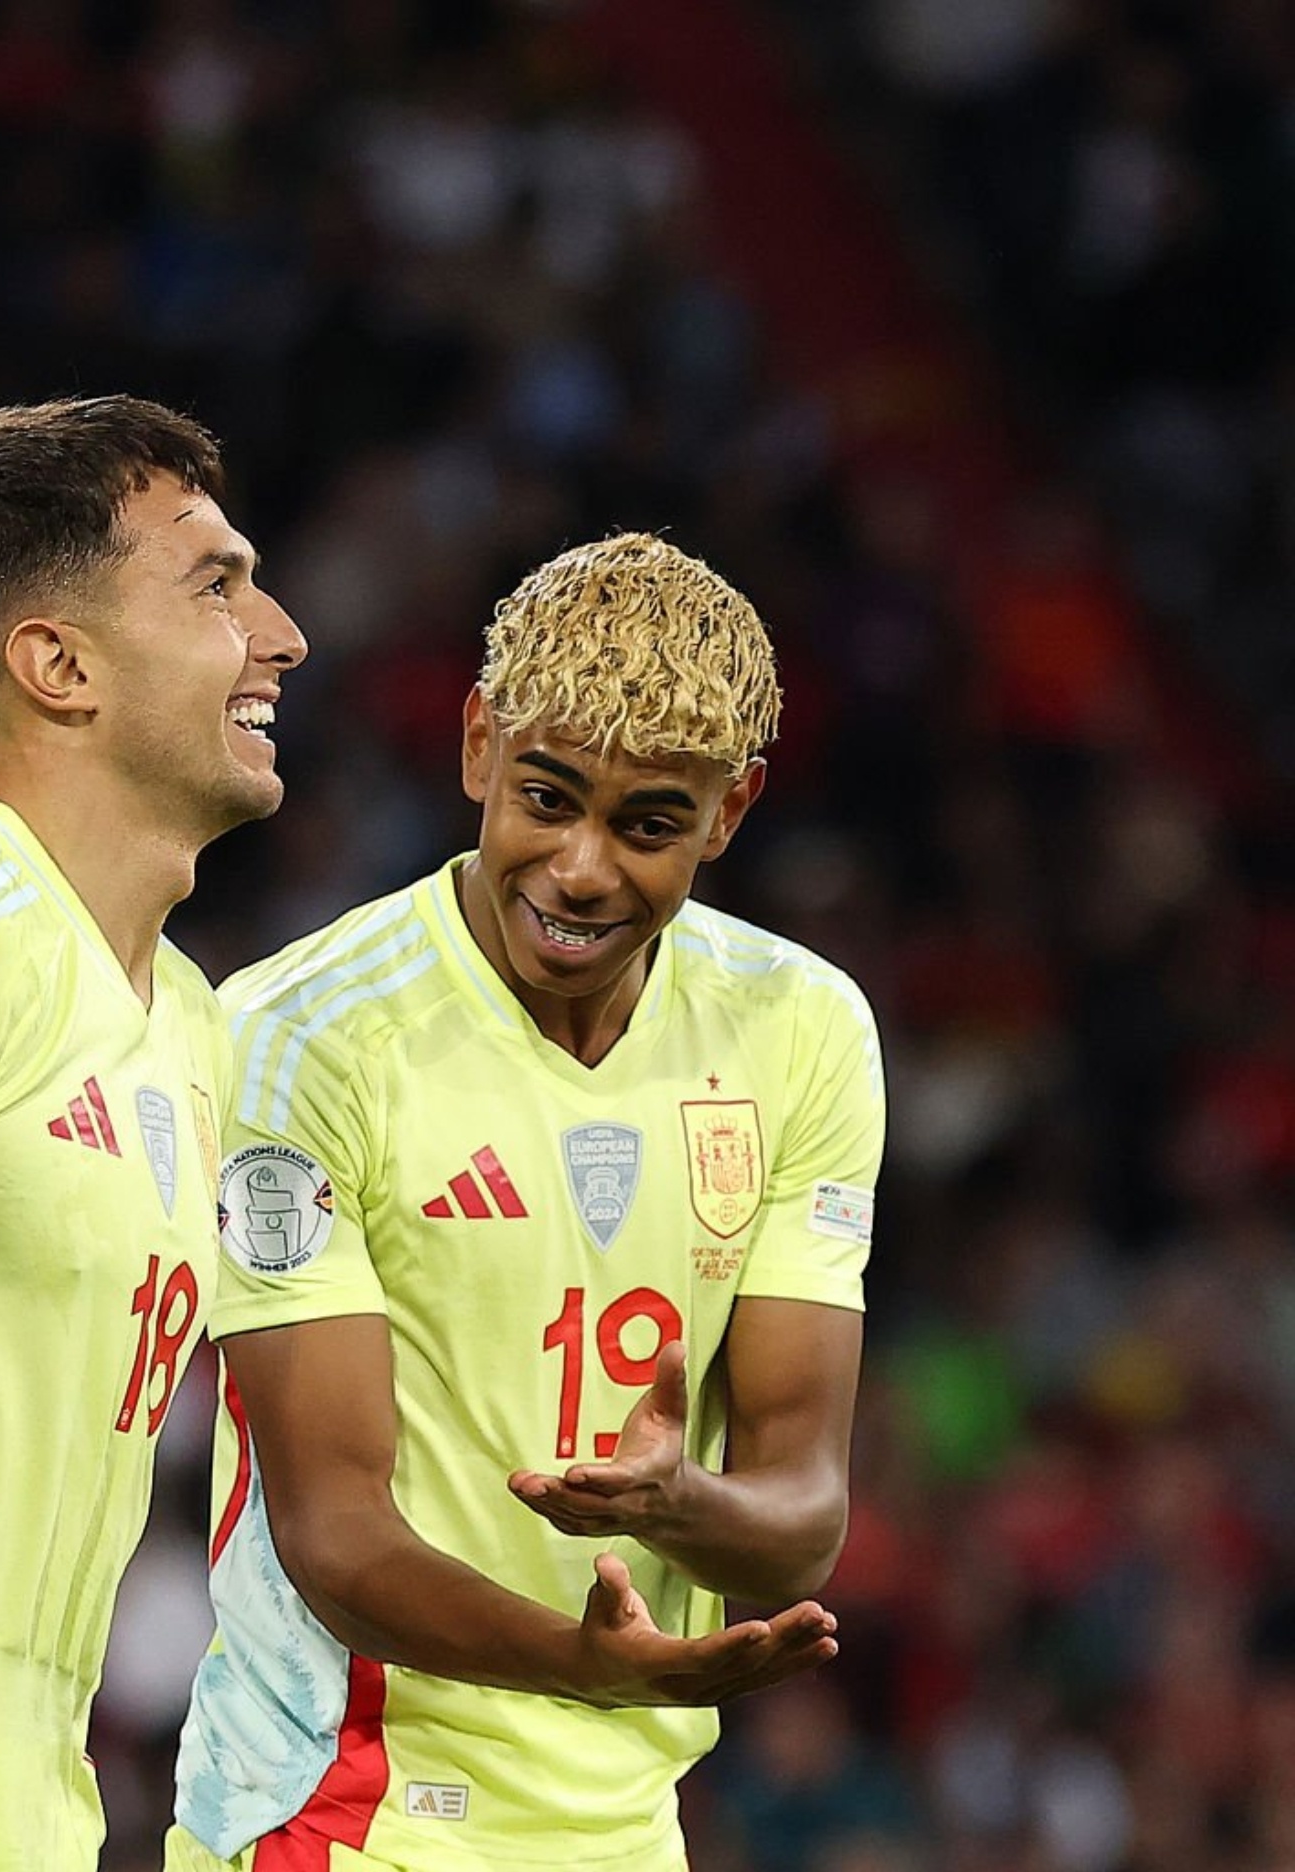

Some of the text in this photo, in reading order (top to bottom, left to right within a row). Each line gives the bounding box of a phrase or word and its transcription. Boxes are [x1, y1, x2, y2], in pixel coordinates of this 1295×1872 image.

[569, 1139, 636, 1154] EUROPEAN
[234, 1146, 276, 1165] NATIONS
[278, 1147, 316, 1171] LEAGUE
[569, 1152, 636, 1166] CHAMPIONS
[587, 1207, 622, 1220] 2024
[115, 1254, 198, 1438] 18
[543, 1286, 683, 1459] 19
